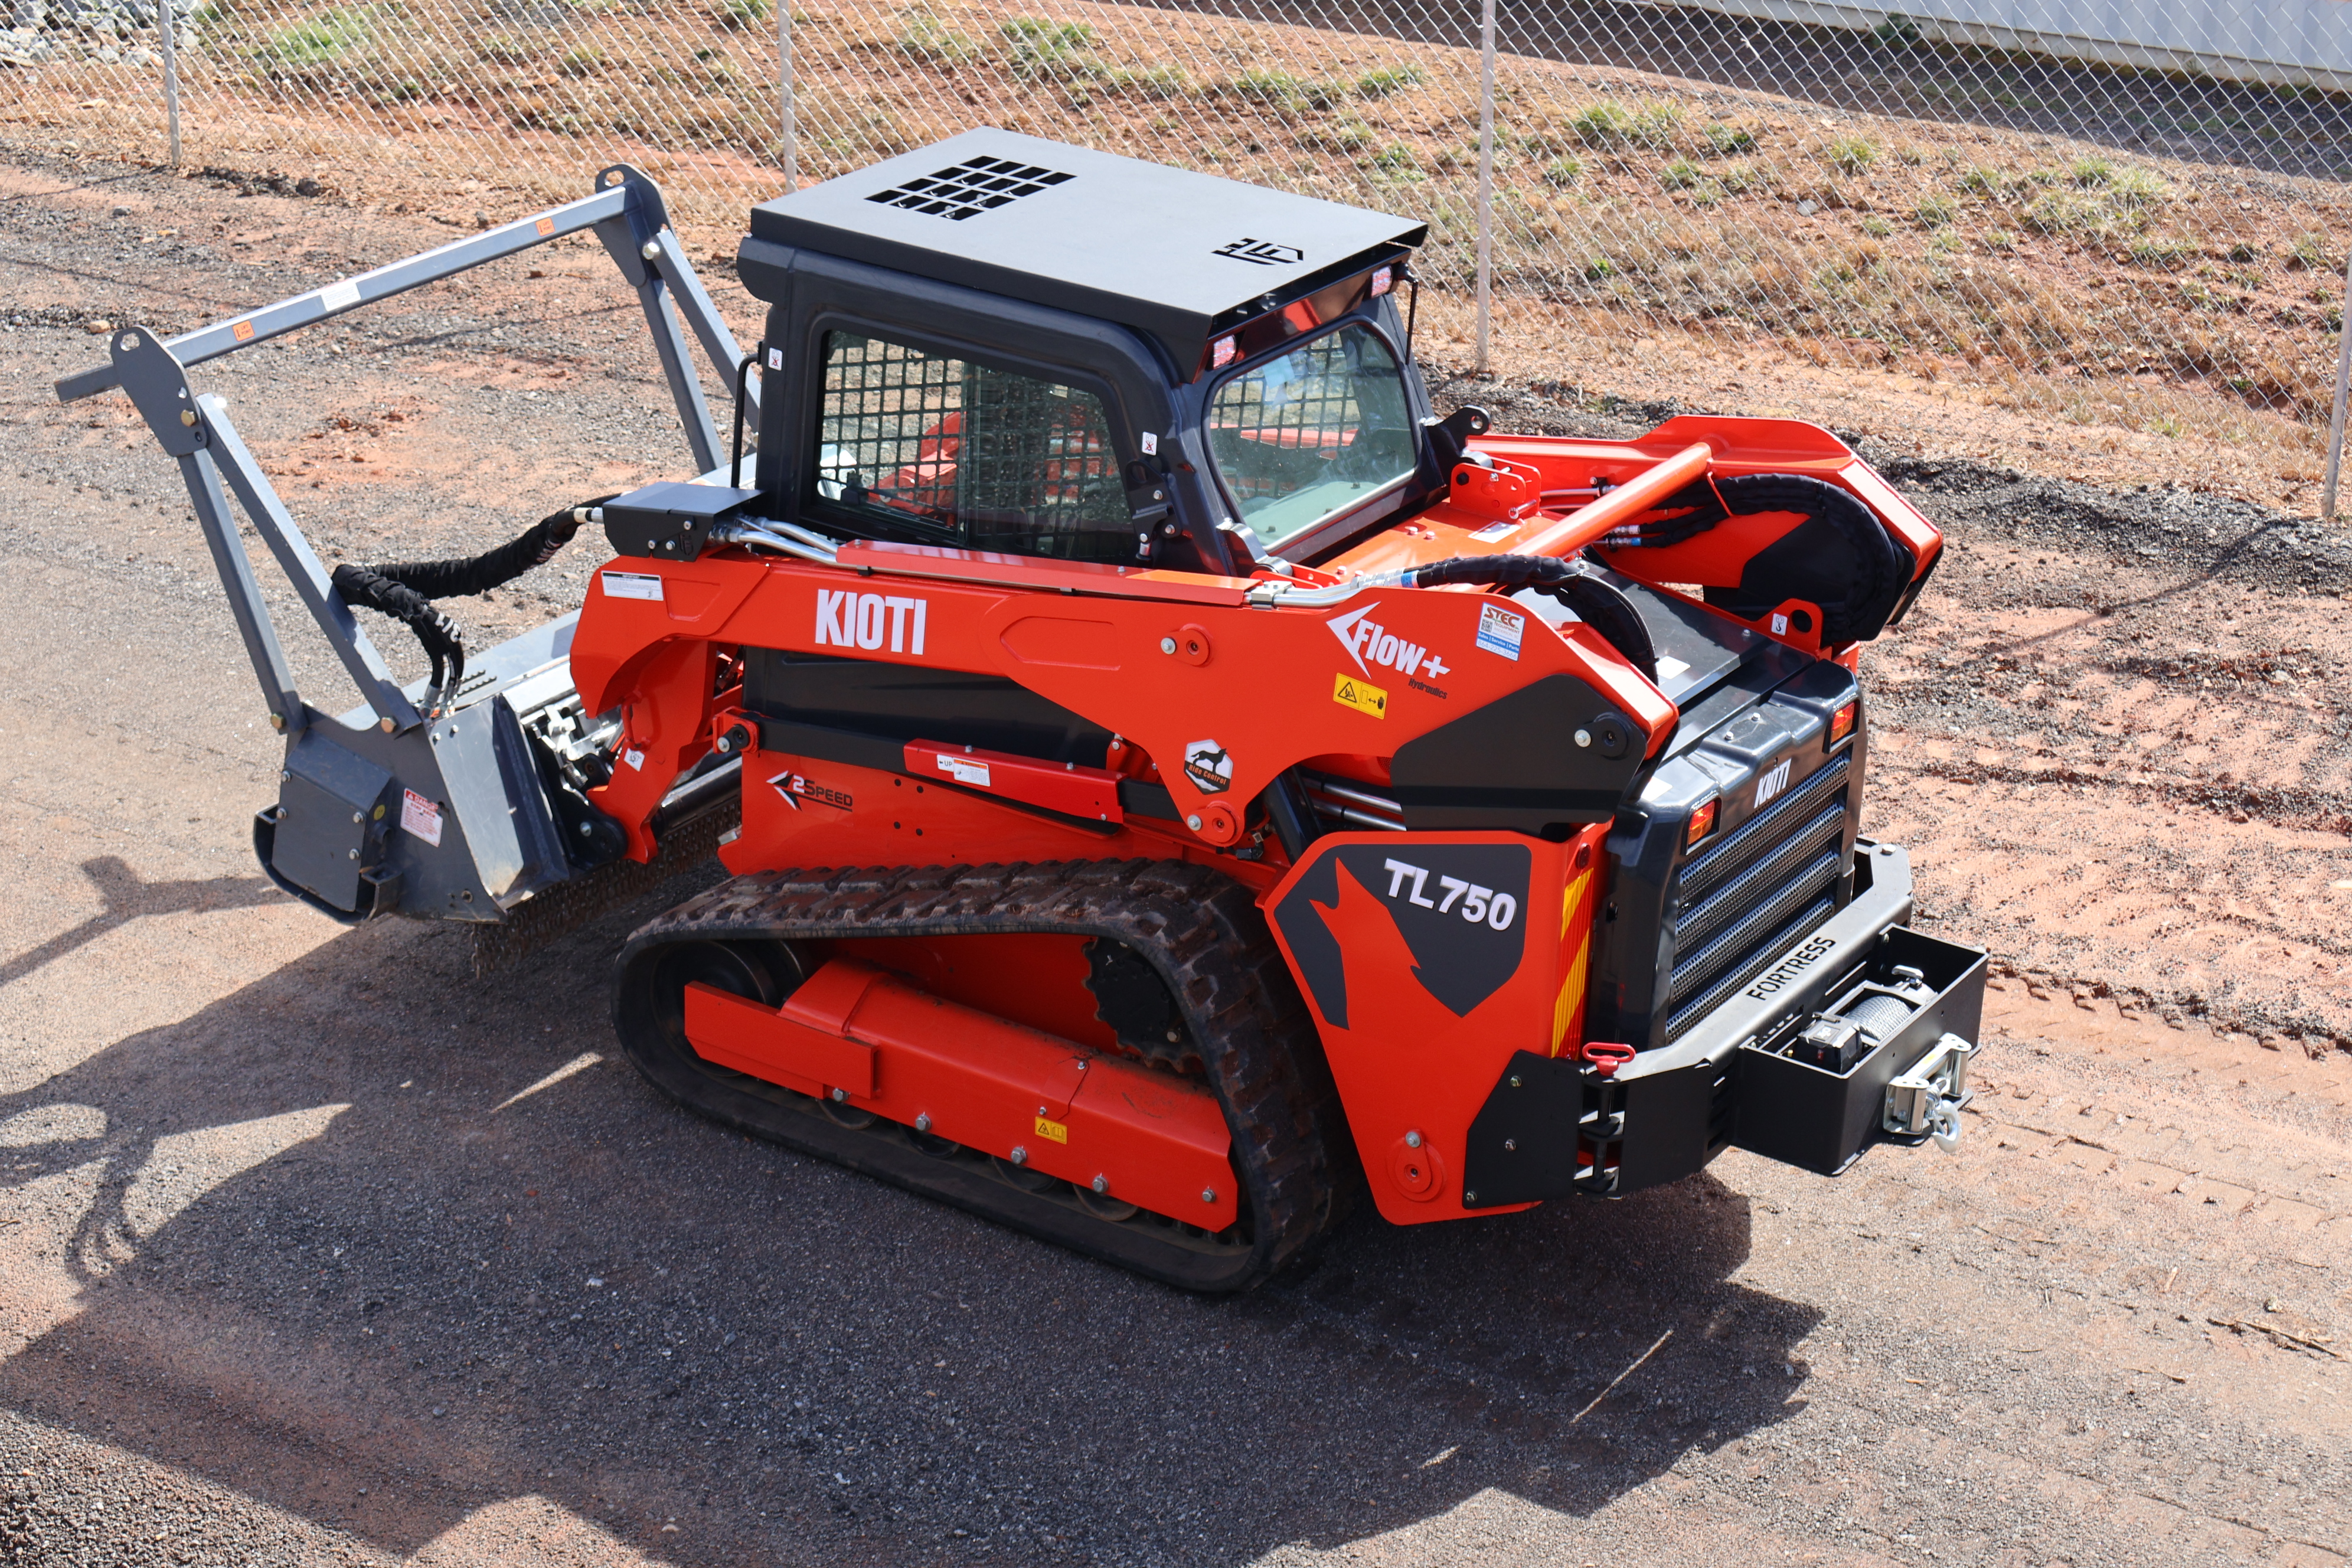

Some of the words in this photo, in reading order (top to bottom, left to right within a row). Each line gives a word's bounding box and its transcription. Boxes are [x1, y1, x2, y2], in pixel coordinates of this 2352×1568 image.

[815, 589, 927, 655] KIOTI
[1484, 606, 1520, 628] STEC
[1495, 622, 1520, 635] EQUIPMENT
[1478, 640, 1517, 659] 864-225-3666
[1491, 637, 1506, 646] Service
[1408, 678, 1448, 700] Hydraulics
[1188, 764, 1202, 775] Ride
[1203, 770, 1227, 785] Control
[1753, 757, 1792, 809] KIOTI
[1384, 858, 1517, 932] TL750
[1745, 936, 1836, 1001] FORTRESS
